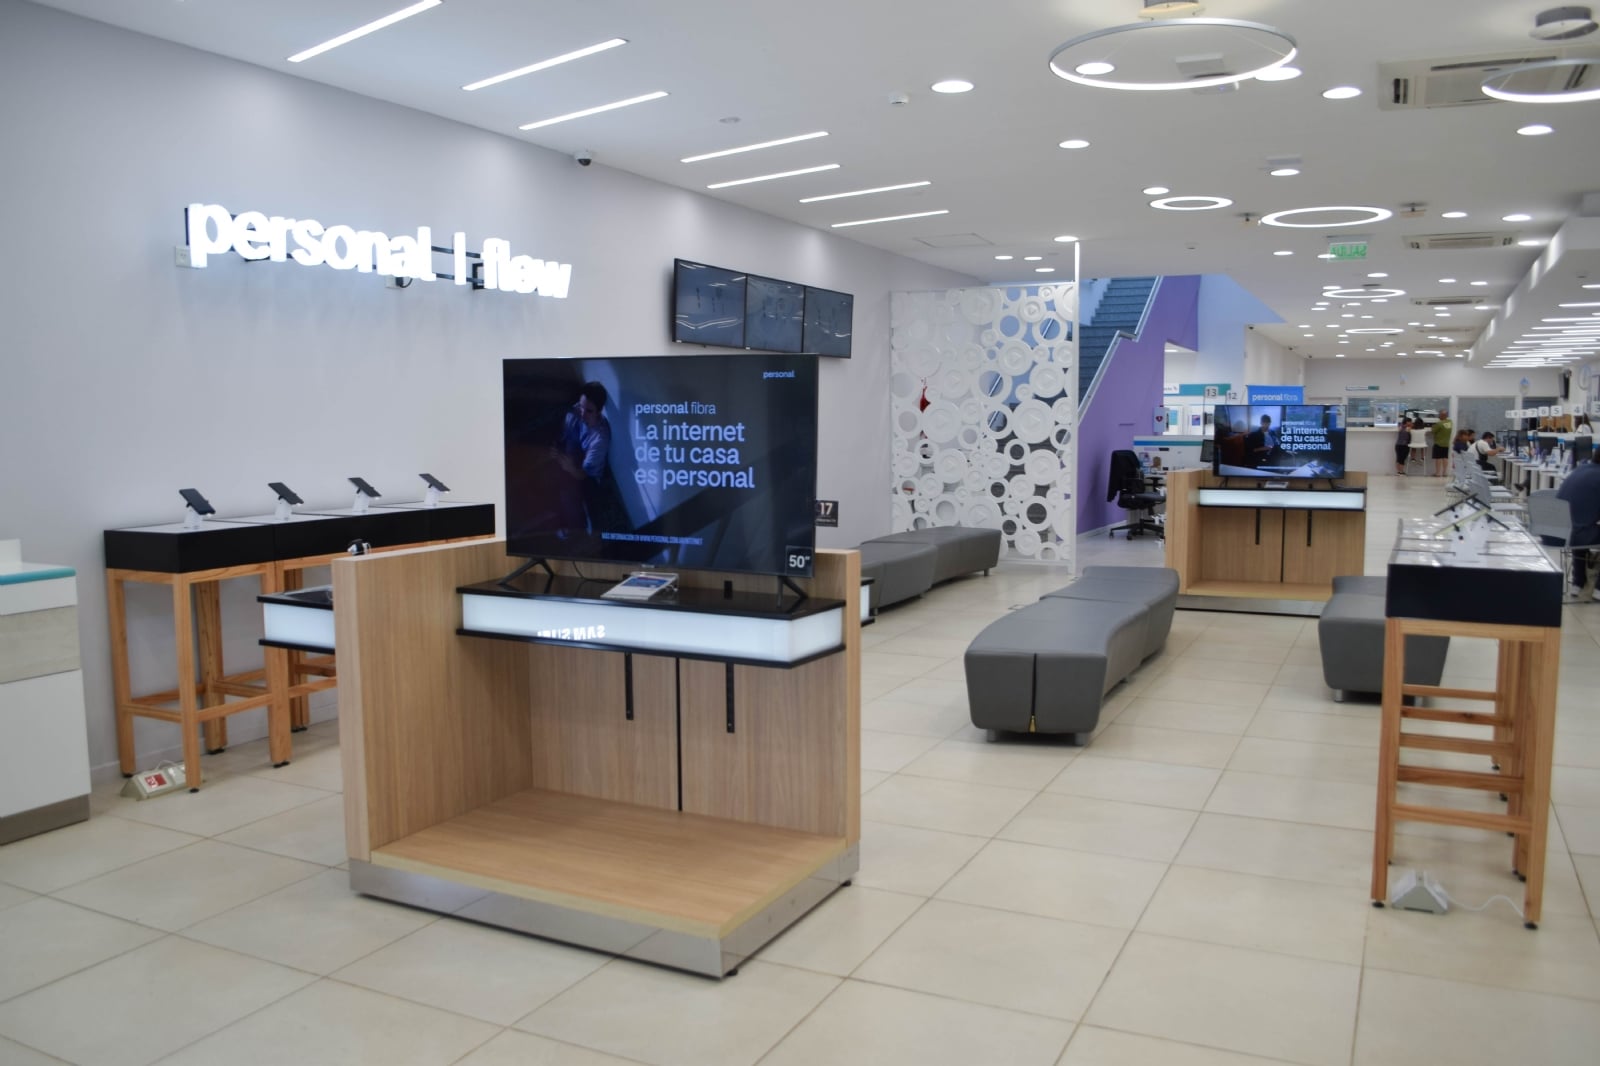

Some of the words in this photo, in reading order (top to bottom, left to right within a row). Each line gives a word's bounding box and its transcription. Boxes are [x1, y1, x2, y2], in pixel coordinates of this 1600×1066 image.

[186, 203, 437, 282] personal
[483, 237, 573, 299] flow
[762, 370, 796, 380] personal
[1206, 388, 1217, 397] 13
[634, 401, 689, 416] personal
[690, 402, 717, 415] fibra
[634, 419, 659, 441] La
[662, 419, 746, 442] internet
[1281, 426, 1292, 435] La
[1292, 426, 1329, 435] internet
[1304, 435, 1326, 443] casa
[1292, 442, 1332, 452] personal
[634, 443, 660, 463] de
[665, 443, 685, 464] tu
[689, 447, 741, 465] casa
[634, 468, 658, 485] es
[662, 467, 756, 490] personal
[820, 502, 833, 515] 17
